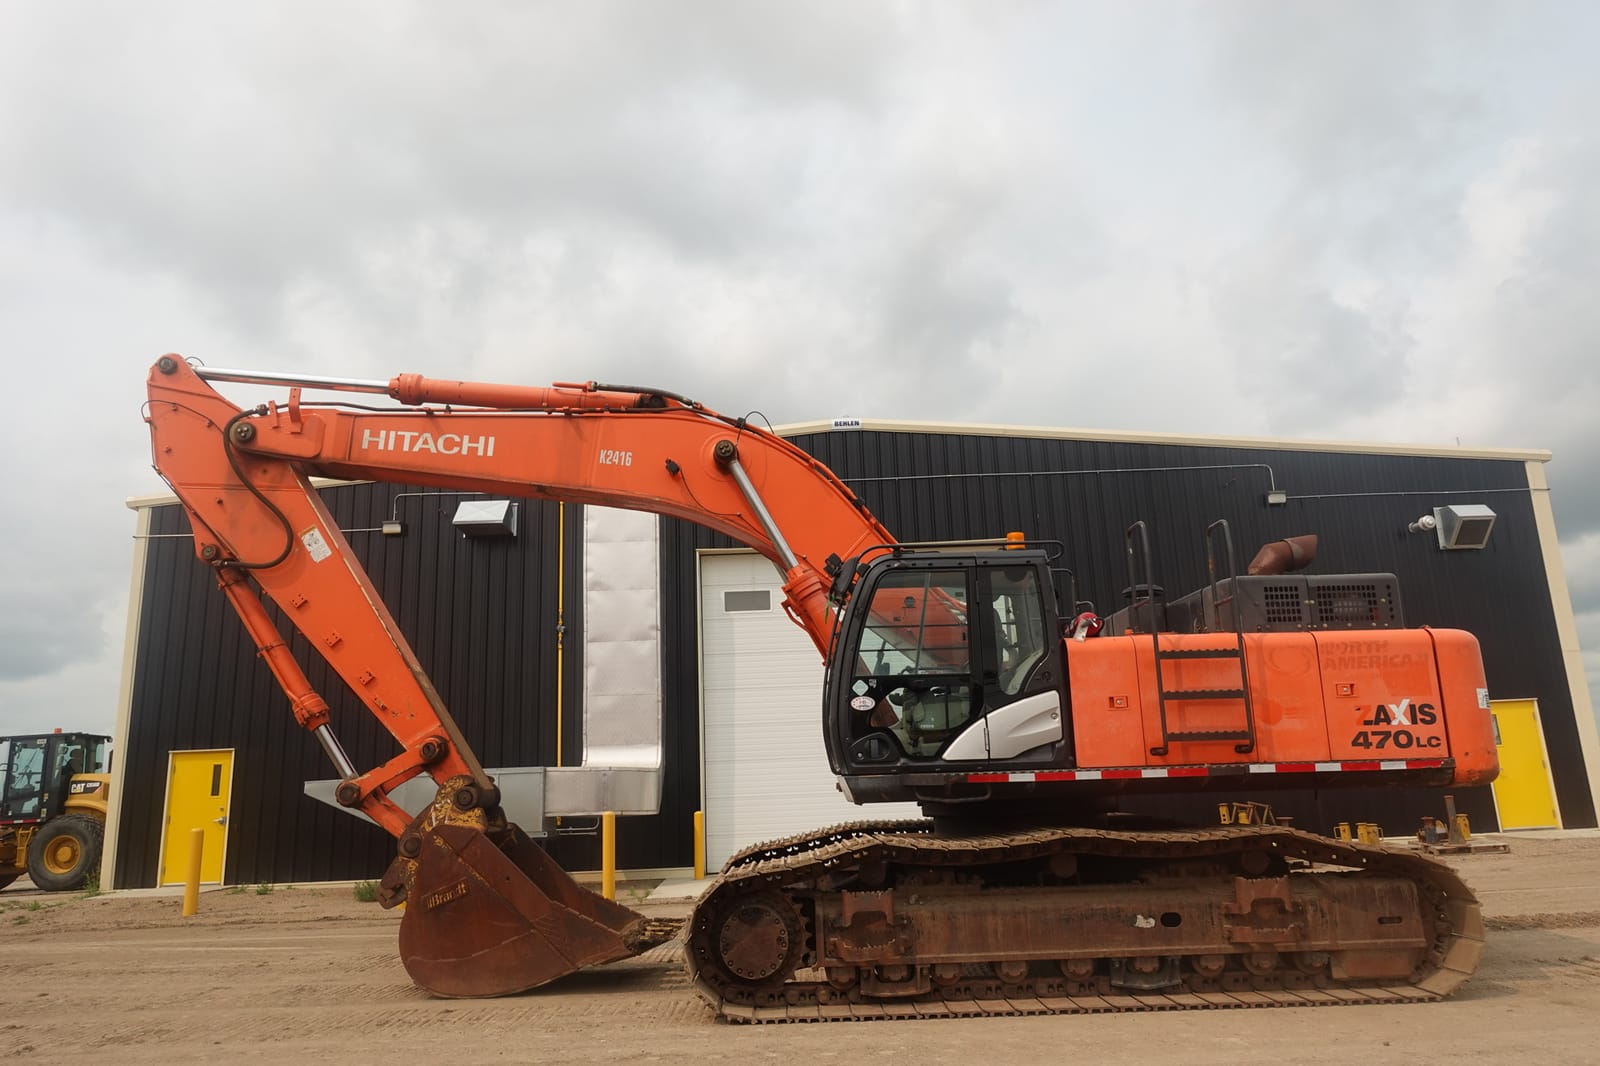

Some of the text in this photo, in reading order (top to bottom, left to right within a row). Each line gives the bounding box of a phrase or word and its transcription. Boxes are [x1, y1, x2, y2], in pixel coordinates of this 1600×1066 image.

[361, 429, 495, 457] HITACHI
[599, 449, 633, 467] K2416
[71, 783, 85, 793] CAT
